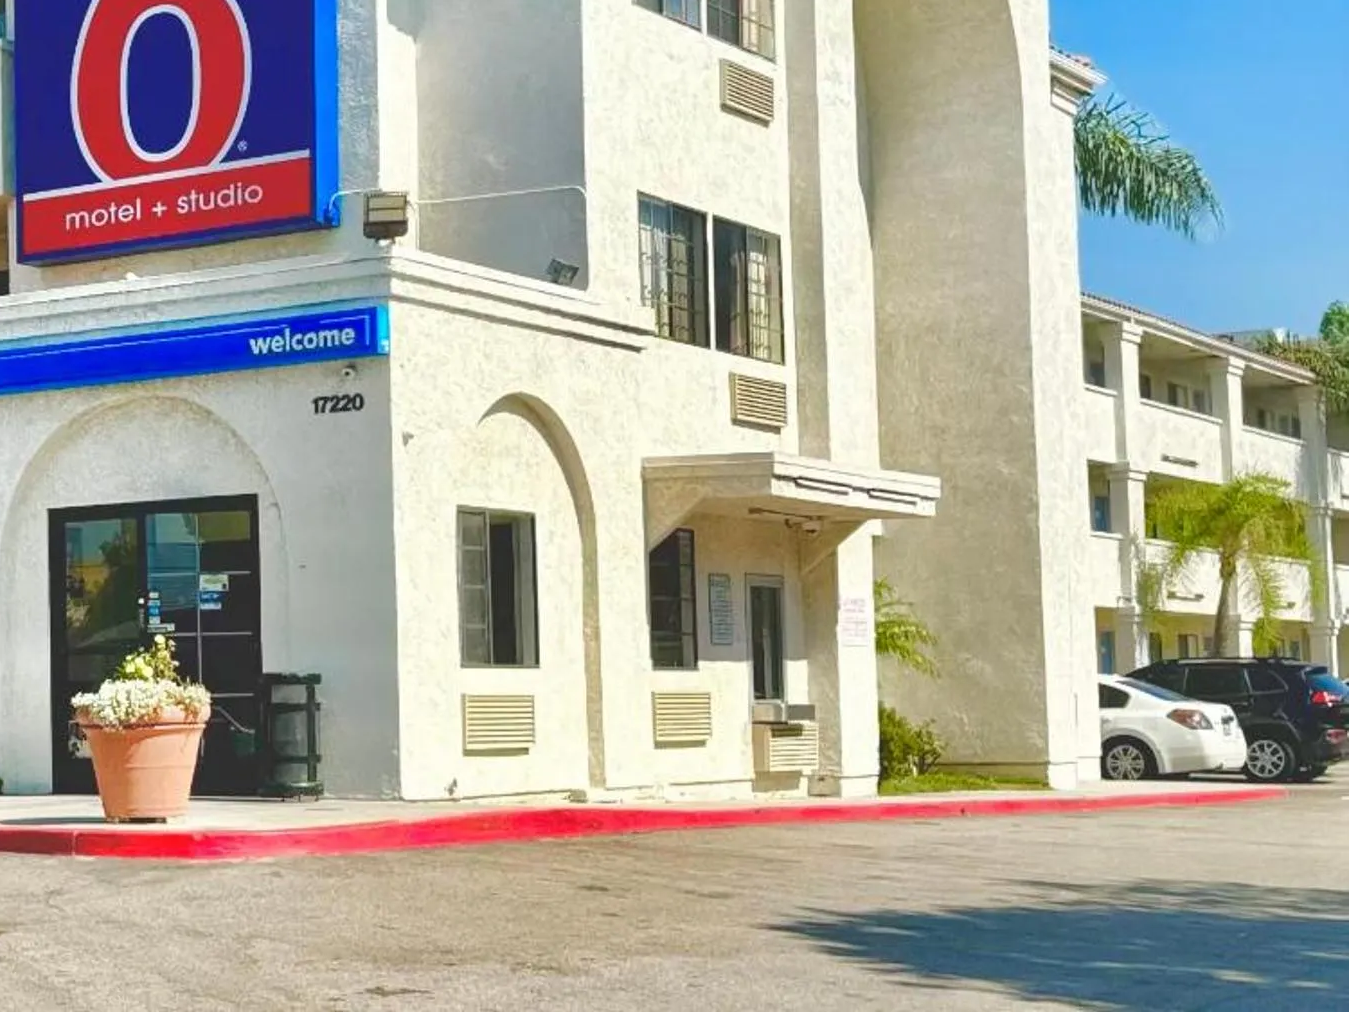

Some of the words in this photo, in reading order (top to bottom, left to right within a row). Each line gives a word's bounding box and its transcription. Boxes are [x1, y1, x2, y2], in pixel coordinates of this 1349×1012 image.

[65, 198, 141, 230] motel
[152, 201, 167, 217] +
[177, 182, 263, 214] studio
[249, 328, 355, 355] welcome
[312, 393, 364, 415] 17220
